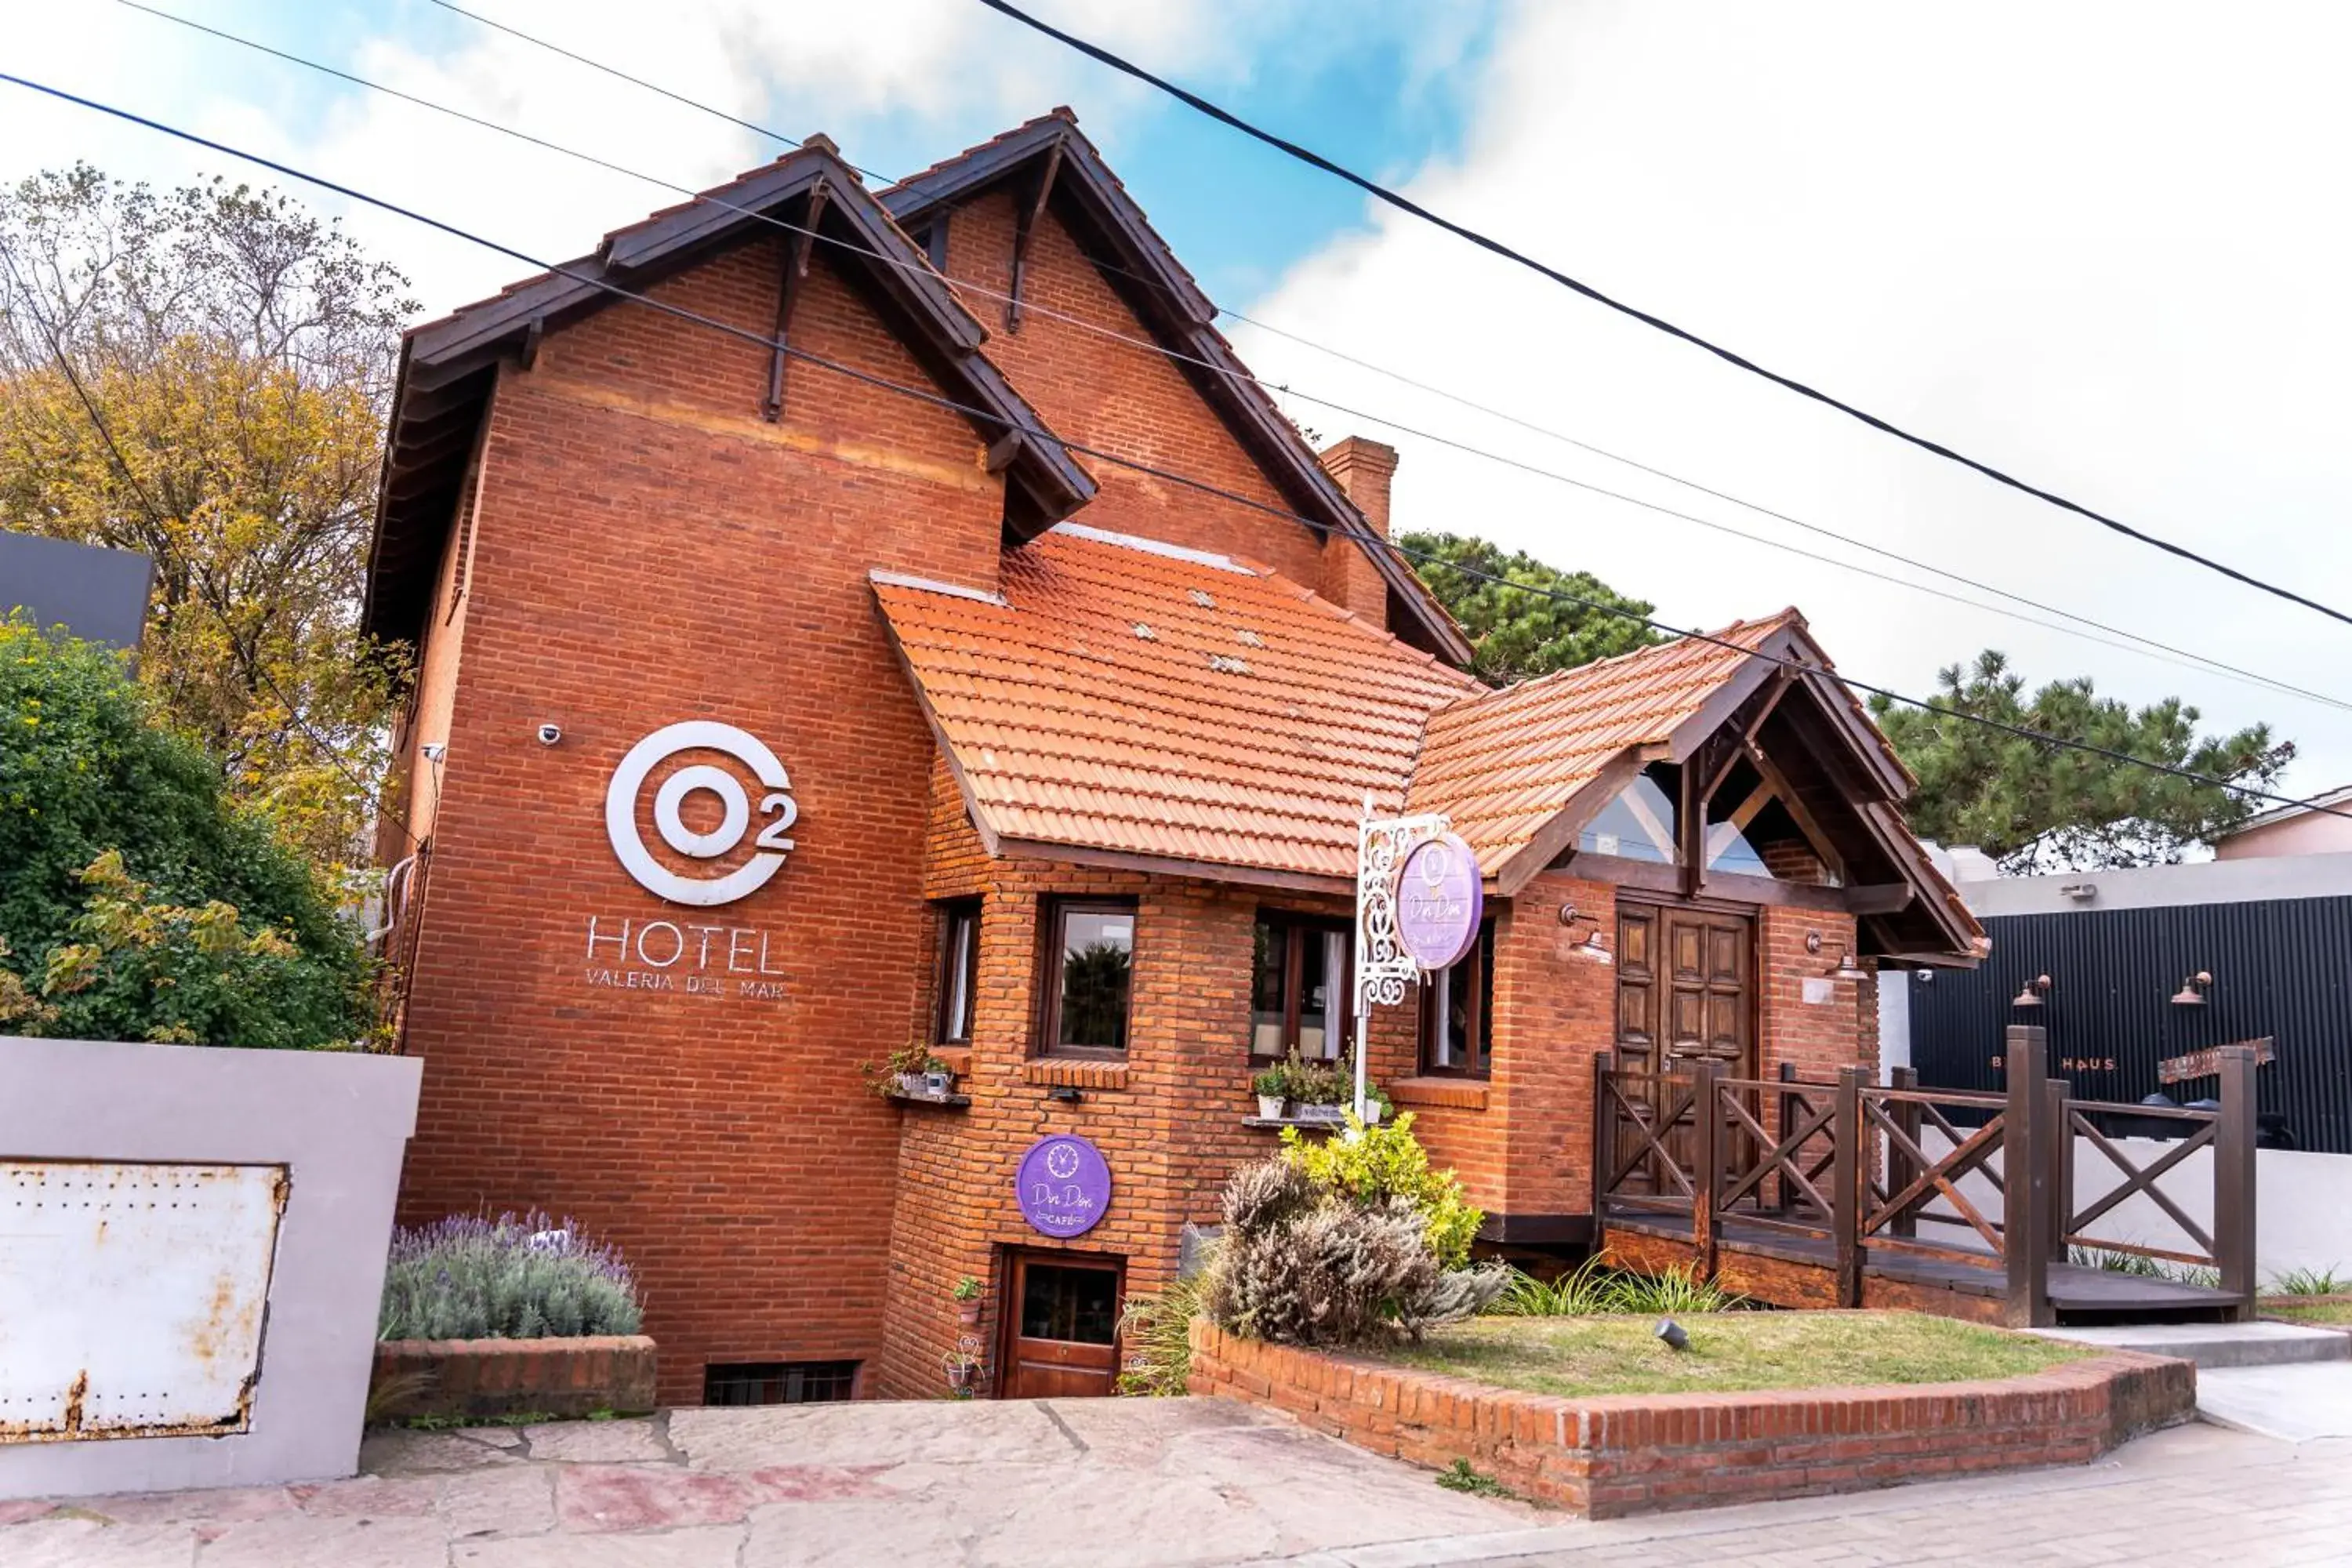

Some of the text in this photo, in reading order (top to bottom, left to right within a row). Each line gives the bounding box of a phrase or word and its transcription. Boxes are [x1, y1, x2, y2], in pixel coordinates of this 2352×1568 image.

[588, 915, 784, 975] HOTEL
[586, 968, 784, 1000] VALERIA DEL MAR
[2062, 1057, 2114, 1071] HAUS
[1031, 1182, 1060, 1206] Din
